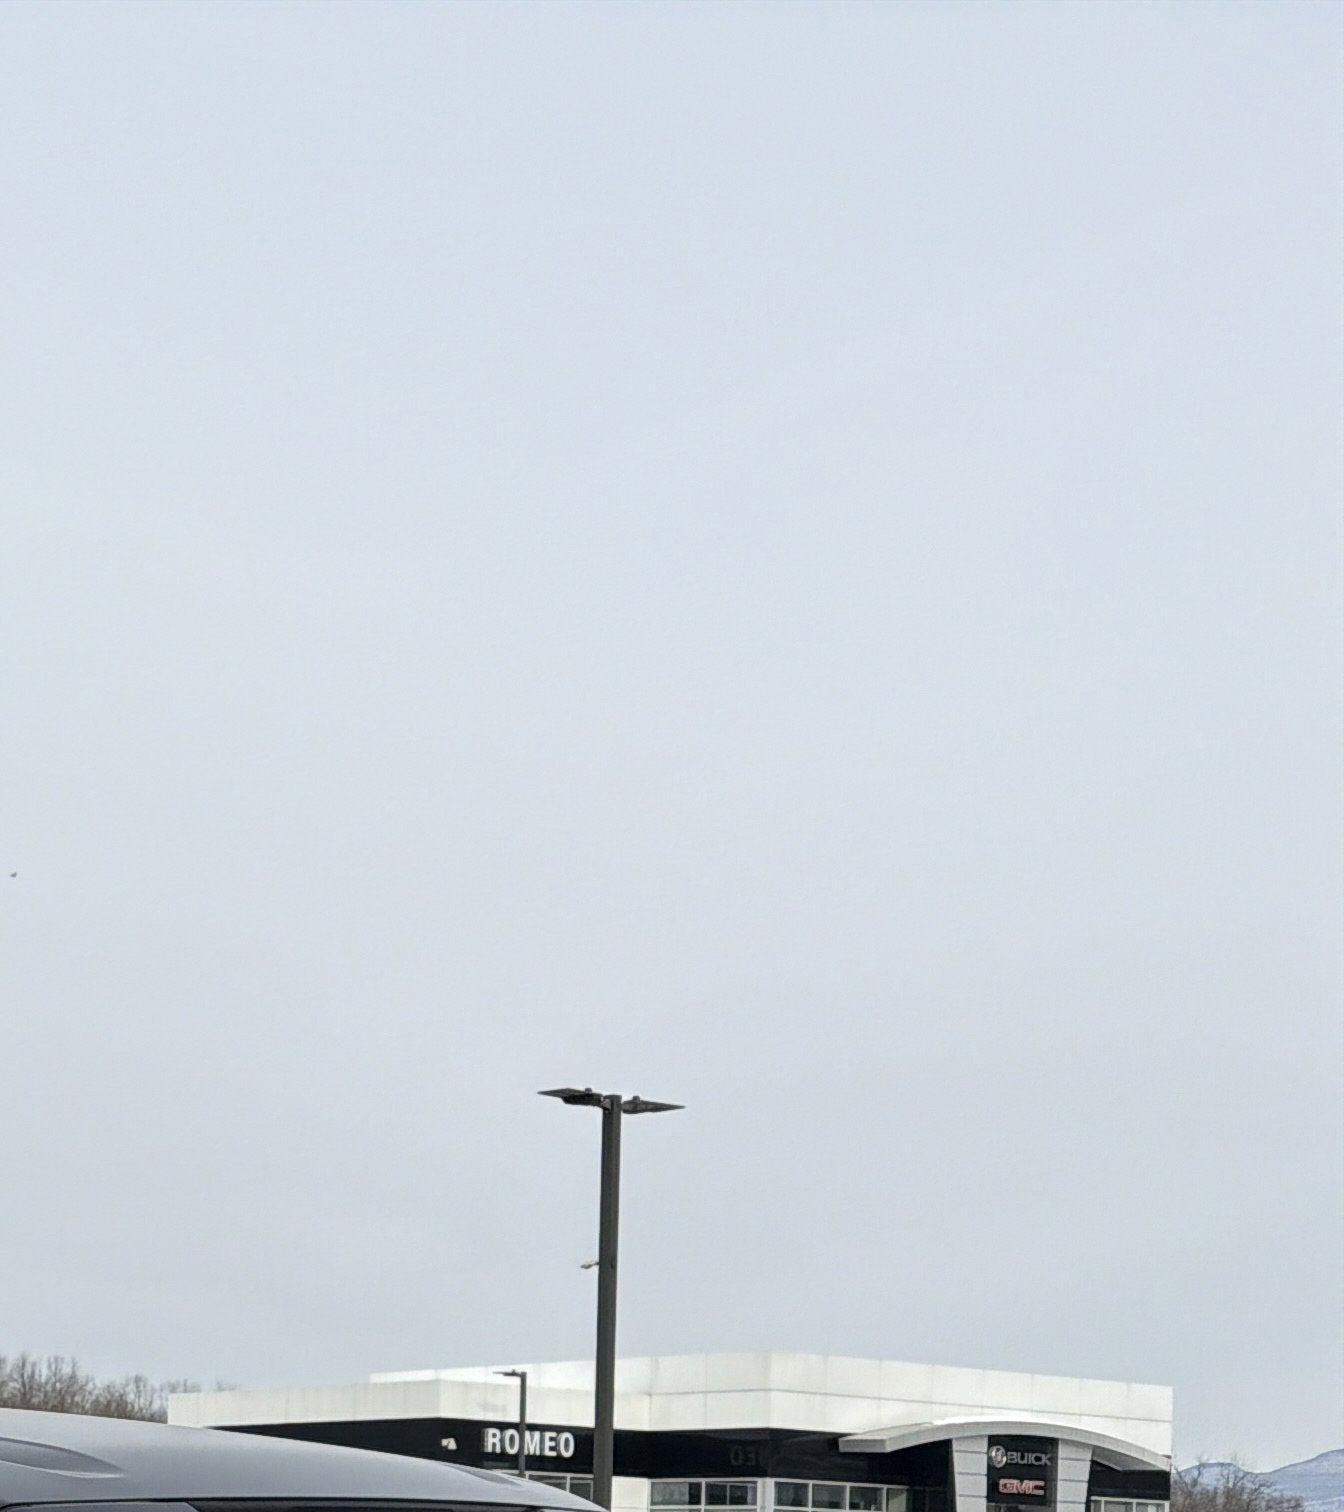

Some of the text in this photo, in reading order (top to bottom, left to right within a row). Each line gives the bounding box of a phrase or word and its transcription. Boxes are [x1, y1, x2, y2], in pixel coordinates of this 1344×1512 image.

[481, 1427, 576, 1459] ROMEO
[1006, 1451, 1052, 1466] BUICK
[998, 1478, 1046, 1496] GMC
